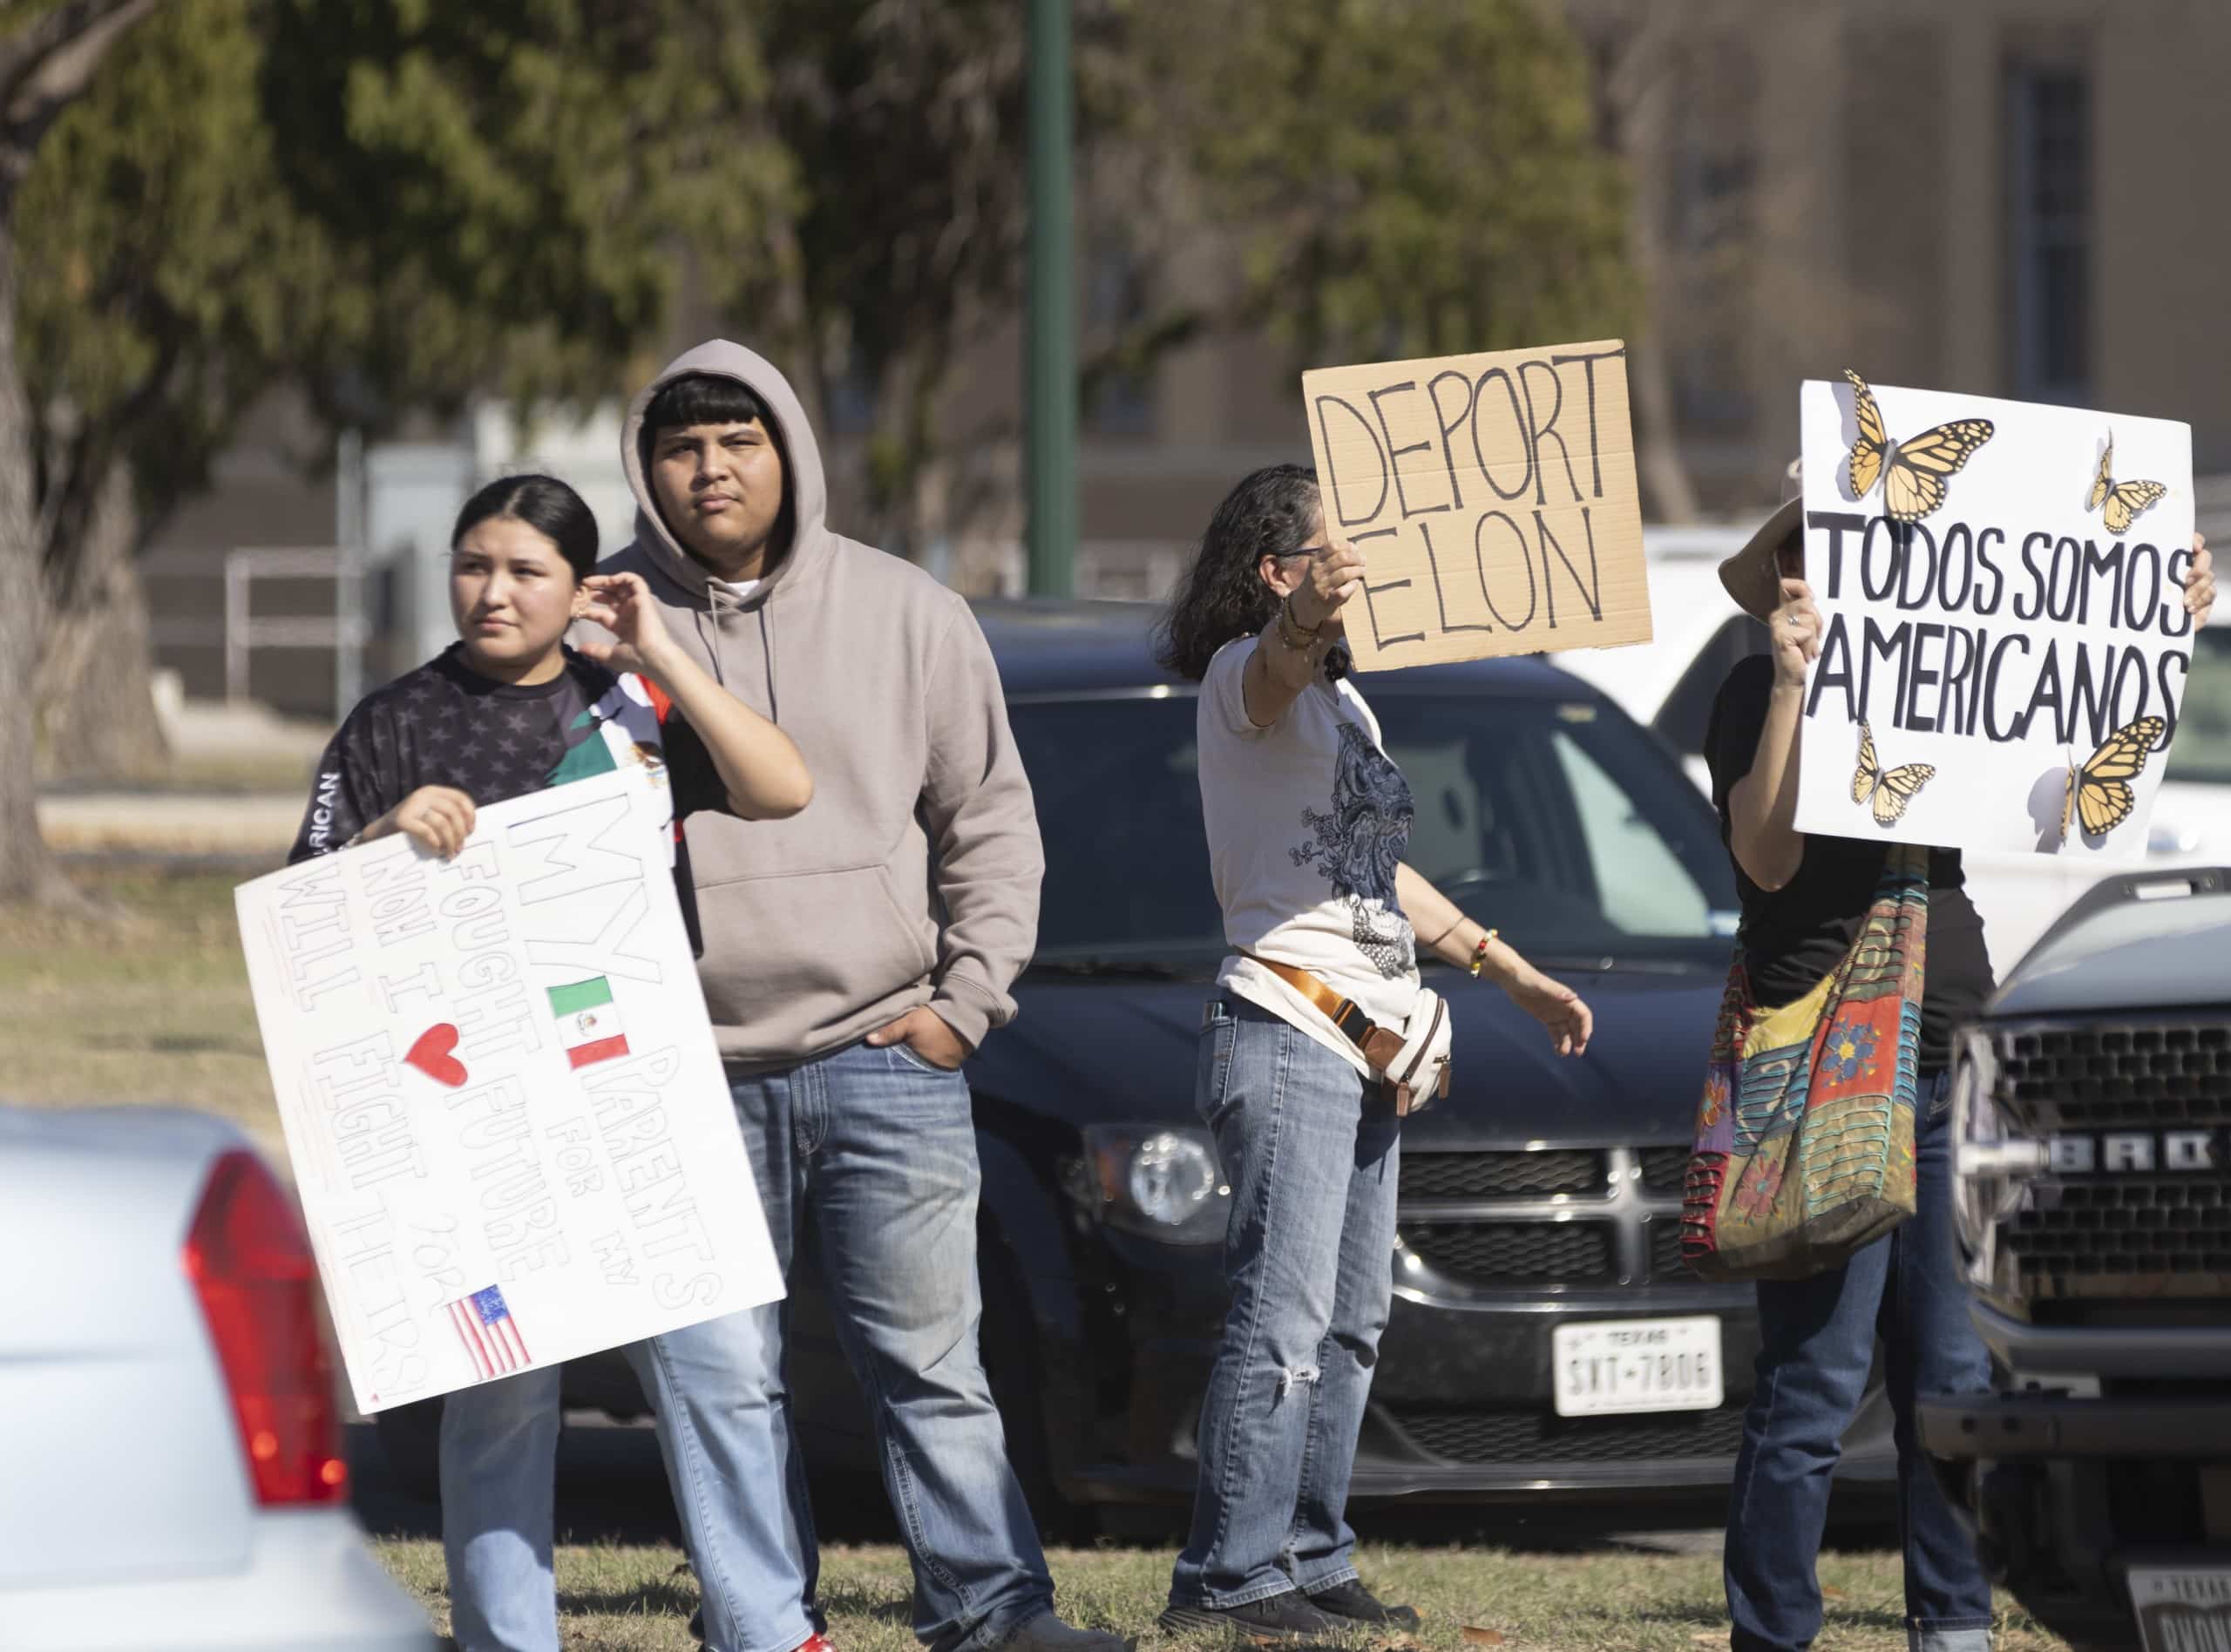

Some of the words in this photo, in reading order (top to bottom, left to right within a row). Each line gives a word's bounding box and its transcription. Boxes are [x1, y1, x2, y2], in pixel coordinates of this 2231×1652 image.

[1315, 348, 1626, 528] DEPORT
[1346, 505, 1604, 653] ELON
[1807, 510, 2004, 616] TODOS
[2013, 531, 2195, 638] SOMOS
[1803, 612, 2189, 754] AMERICANOS
[278, 861, 362, 1013] WILL
[360, 847, 437, 948] NOW
[438, 839, 543, 1060] FOUGHT
[506, 791, 662, 985] MY
[377, 961, 444, 1014] I
[313, 1028, 429, 1192] FIGHT
[444, 1073, 572, 1283] FUTURE
[581, 1044, 724, 1310] PARENTS
[544, 1115, 605, 1199] FOR
[590, 1228, 641, 1285] MY
